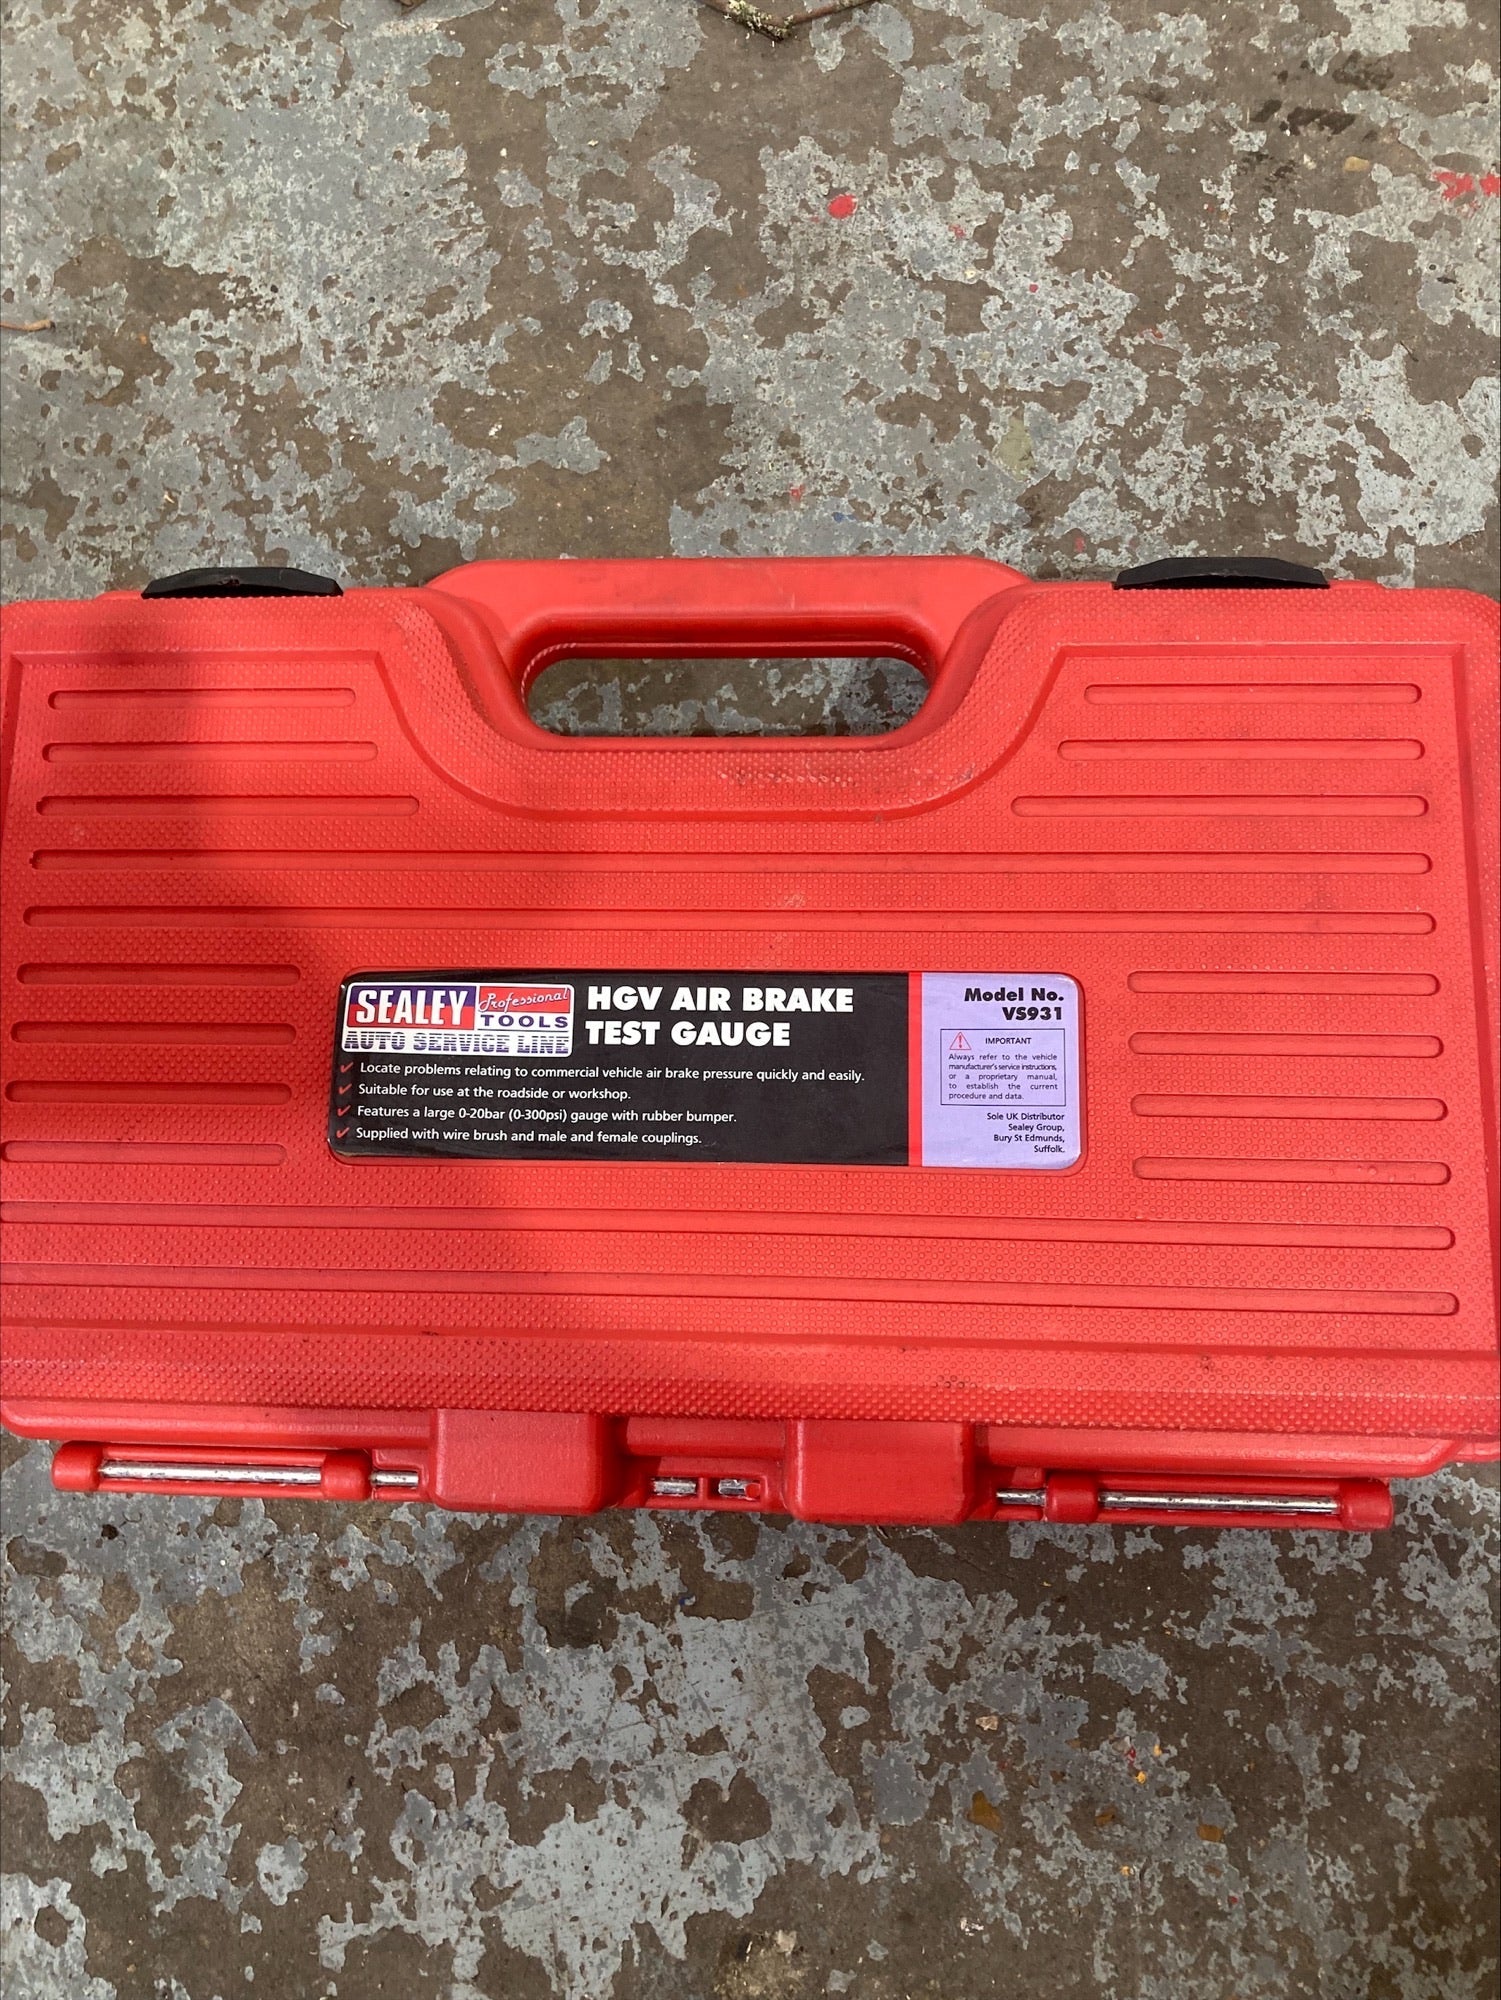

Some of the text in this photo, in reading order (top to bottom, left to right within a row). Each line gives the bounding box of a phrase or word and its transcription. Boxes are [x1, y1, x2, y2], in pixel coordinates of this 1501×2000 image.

[479, 988, 569, 1012] Professional
[587, 986, 853, 1013] HGV AIR BRAKE
[964, 987, 1064, 1002] Model No.
[355, 988, 469, 1026] SEALEY
[1002, 1007, 1062, 1020] VS931
[480, 1014, 568, 1028] TOOLS
[345, 1031, 569, 1054] AUTO SERVICE LINE
[585, 1021, 790, 1047] TEST GAUGE
[948, 1054, 974, 1062] Always
[360, 1063, 865, 1083] Locate problems relating to commercial vehicle air brake pressure quickly and easily.
[978, 1073, 1018, 1081] proprietary
[358, 1084, 631, 1102] Suitable for use at the roadside or workshop.
[358, 1106, 737, 1124] Features a large 0-20bar (0-300psi) gauge with rubber bumper.
[356, 1128, 702, 1145] Supplied with wire brush and male and female couplings.
[1008, 1124, 1065, 1132] Sealey Group,
[994, 1134, 1012, 1143] Bury
[1025, 1134, 1064, 1143] Edmunds,
